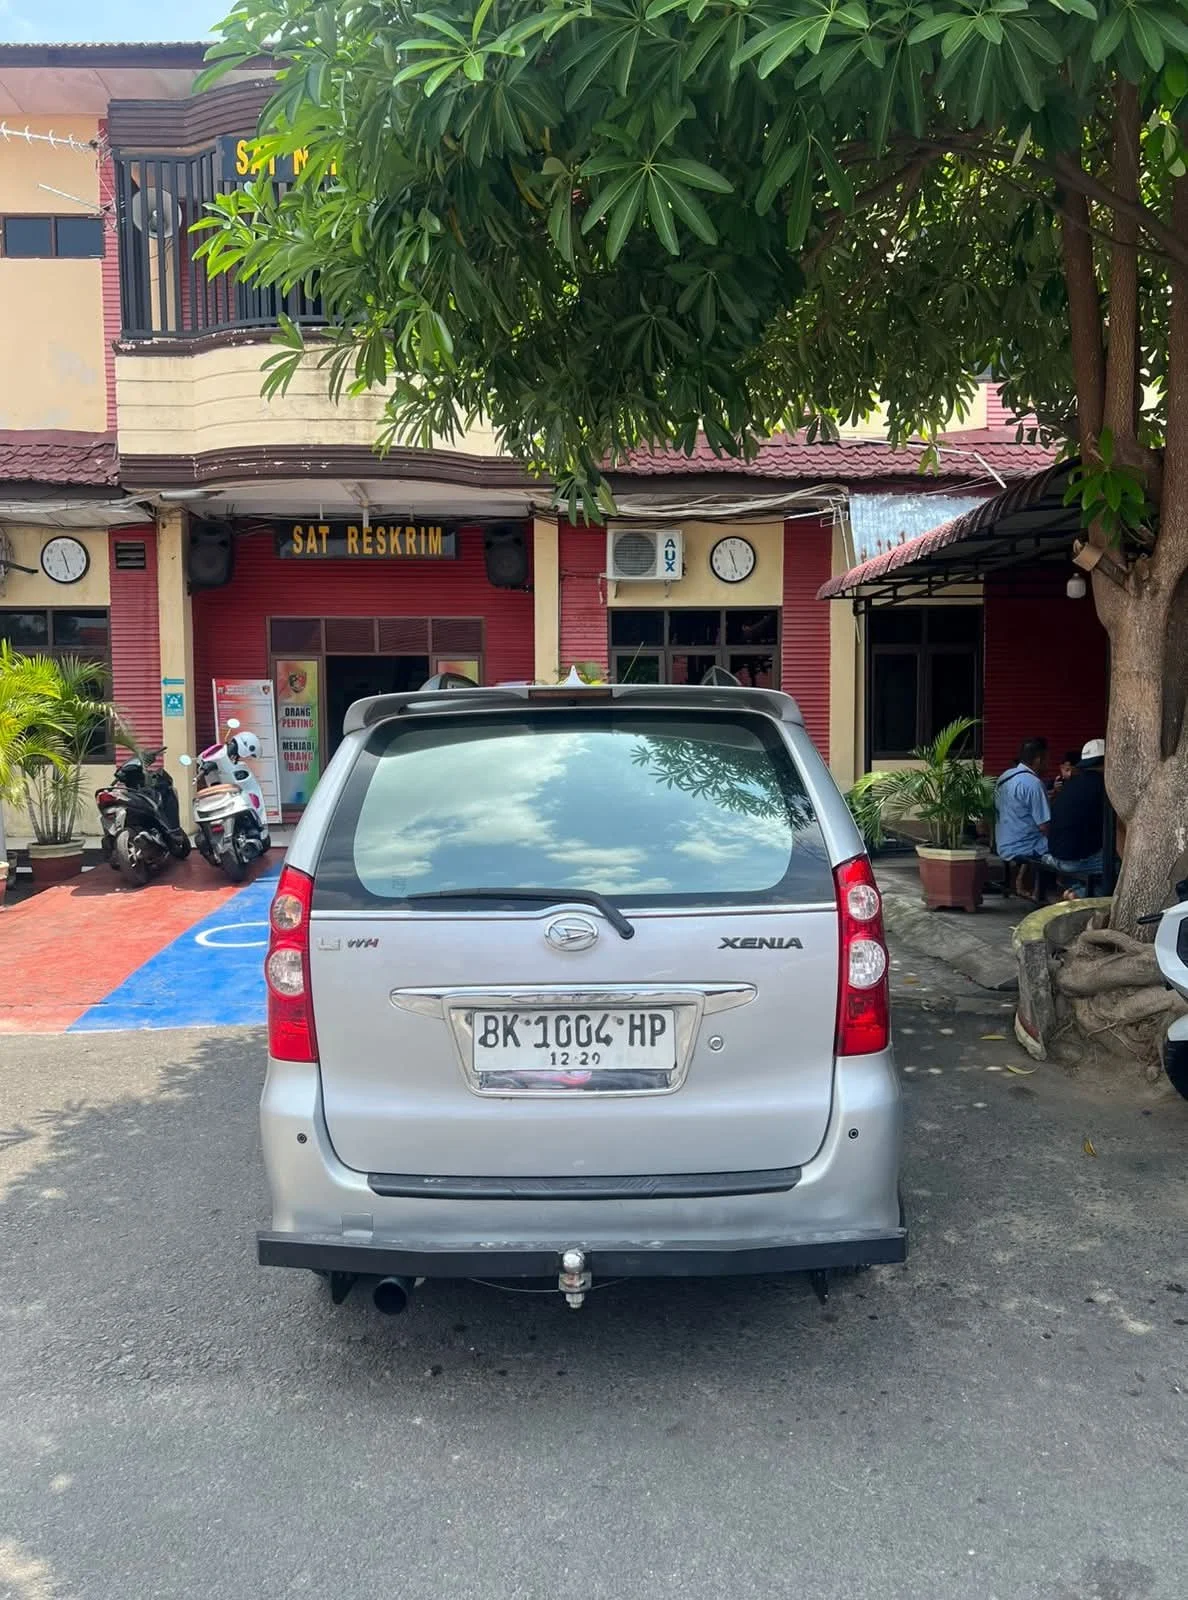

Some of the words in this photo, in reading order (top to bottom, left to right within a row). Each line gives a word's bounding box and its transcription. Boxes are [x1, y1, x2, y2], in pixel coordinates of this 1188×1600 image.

[293, 525, 330, 554] SAT
[347, 526, 443, 556] RESKRIM
[664, 538, 676, 573] AUX
[285, 707, 311, 717] ORANG
[717, 936, 804, 949] XENIA
[478, 1013, 521, 1048] BK
[533, 1013, 614, 1048] 1004
[628, 1013, 666, 1047] HP
